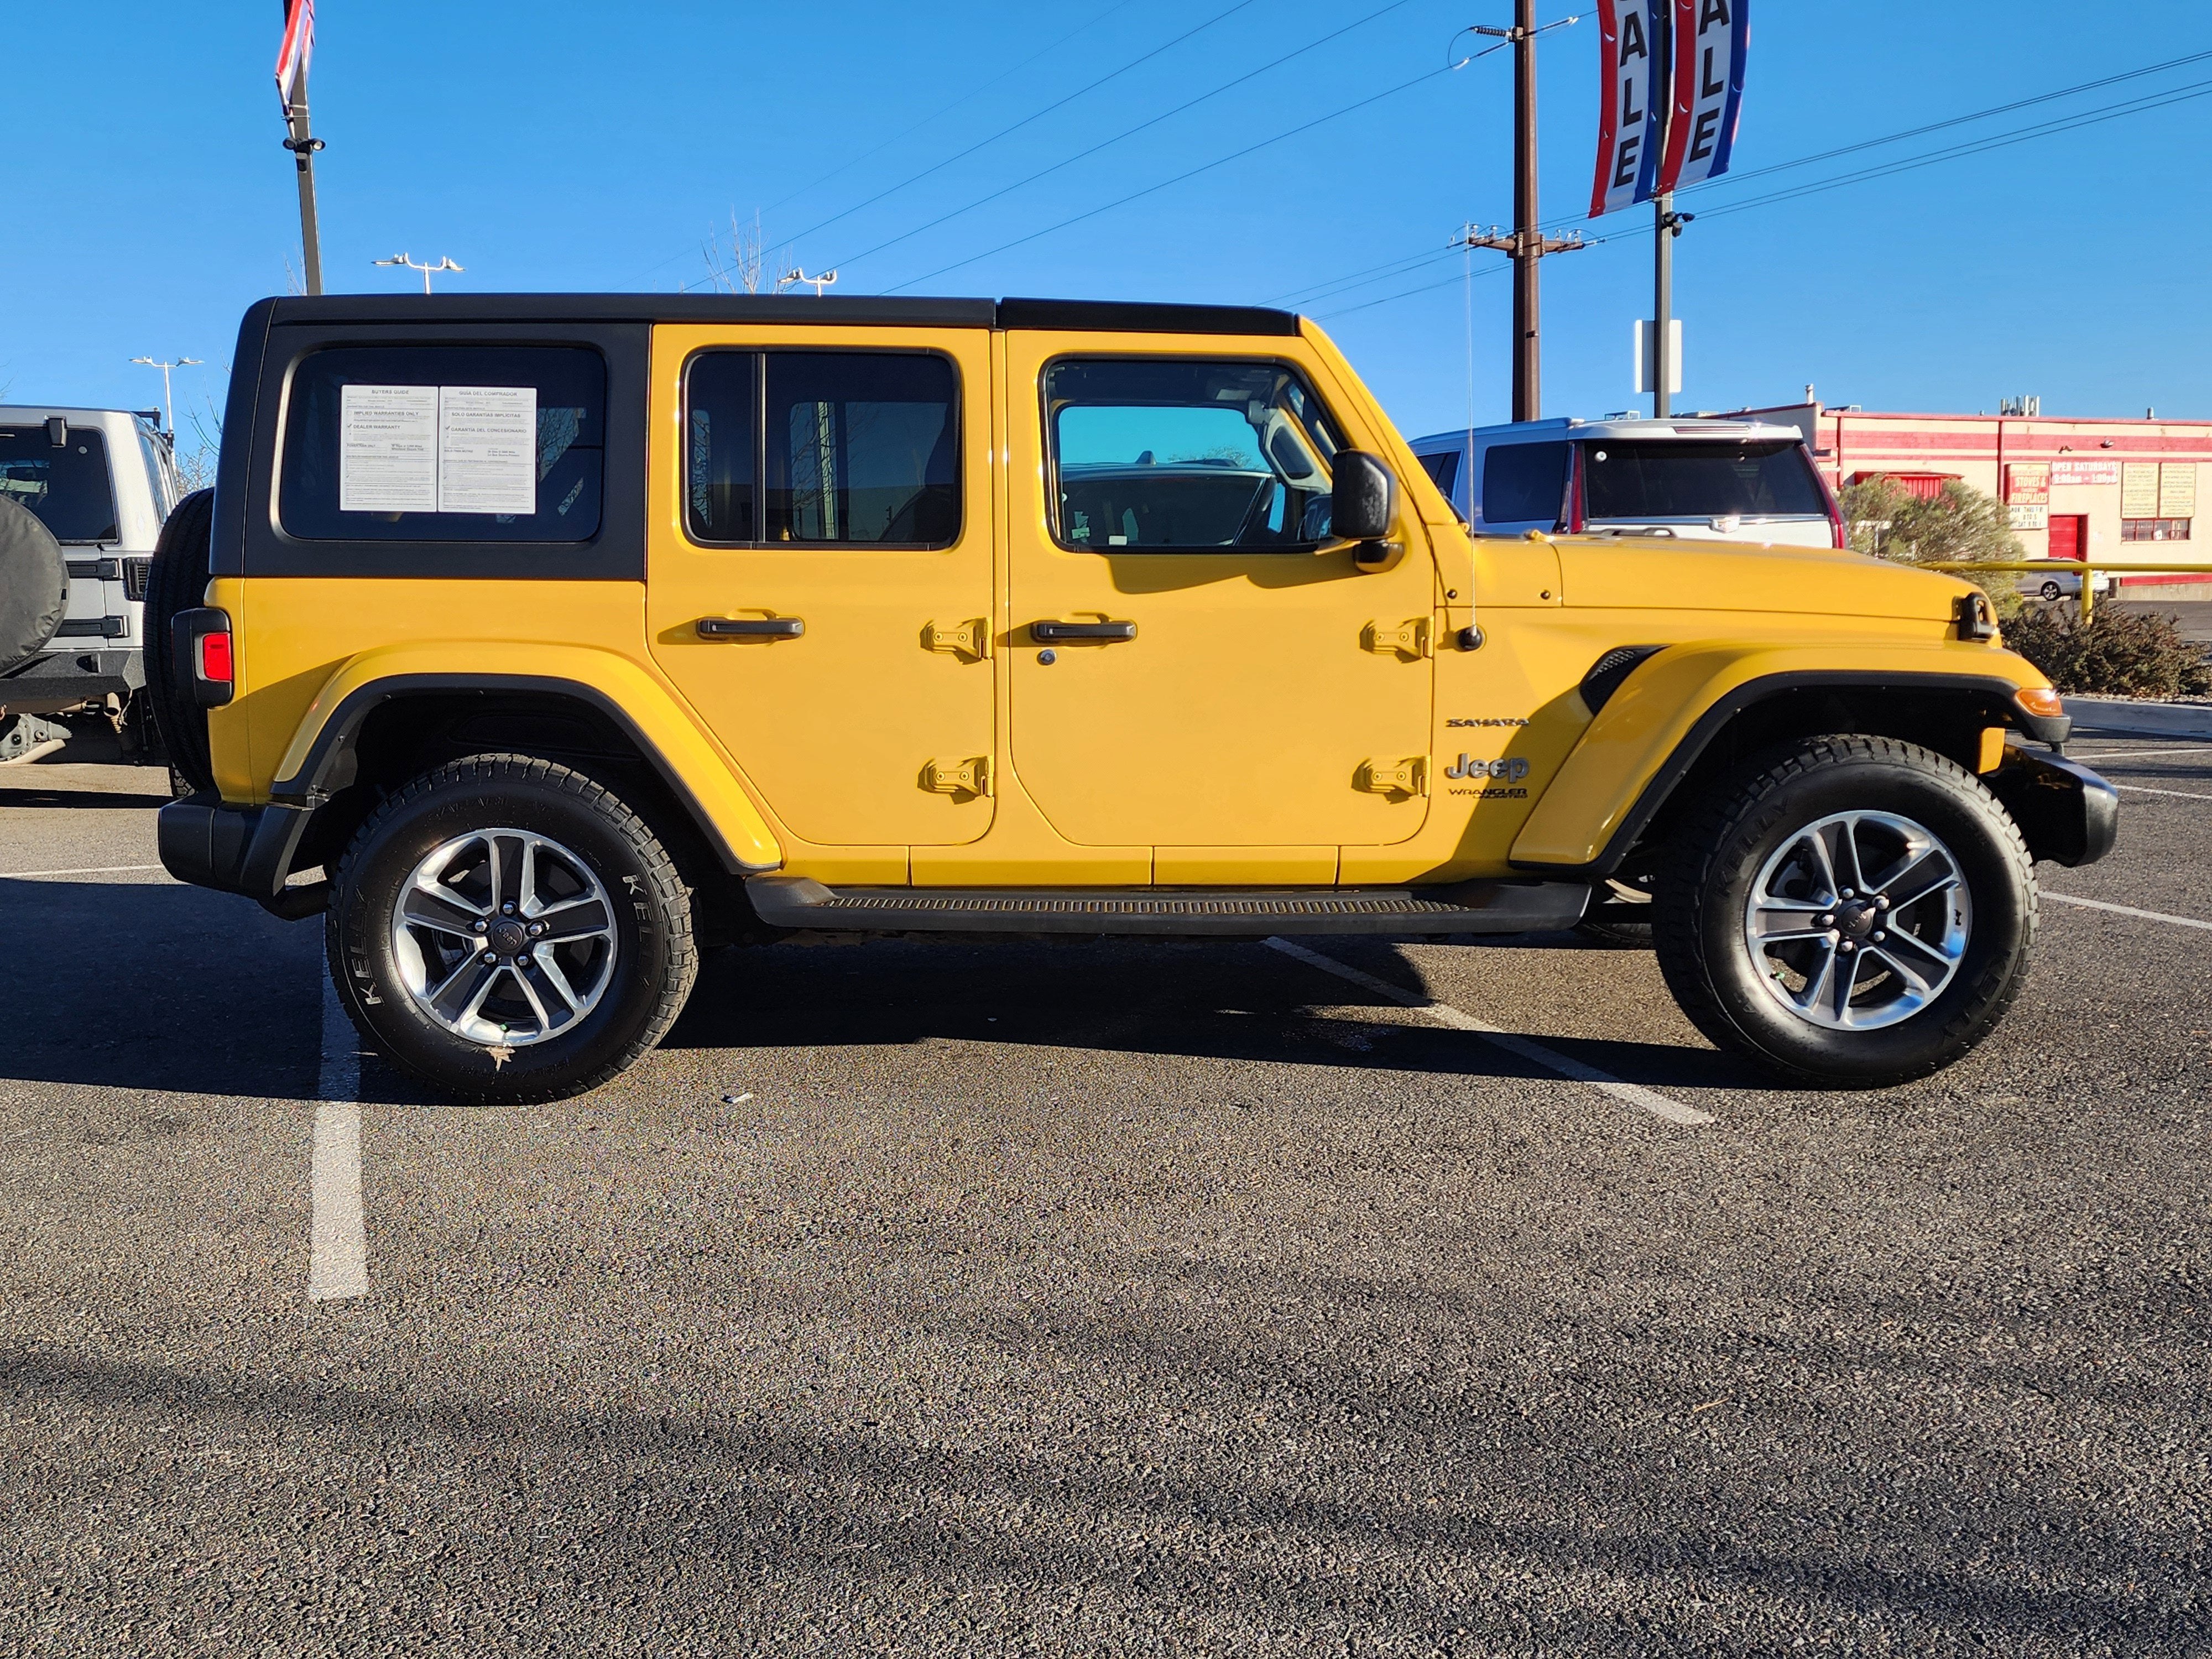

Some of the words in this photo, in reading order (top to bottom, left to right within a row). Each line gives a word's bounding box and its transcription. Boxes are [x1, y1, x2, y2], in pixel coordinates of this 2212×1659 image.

[1613, 0, 1648, 188] ALE
[2052, 462, 2072, 472] OPEN
[2015, 476, 2039, 487] STOVES
[2012, 492, 2048, 504] FIREPLACES
[1446, 718, 1530, 727] SAHARA
[1444, 753, 1529, 783] Jeep
[498, 927, 518, 946] Jeep
[349, 886, 385, 1006] KELLY
